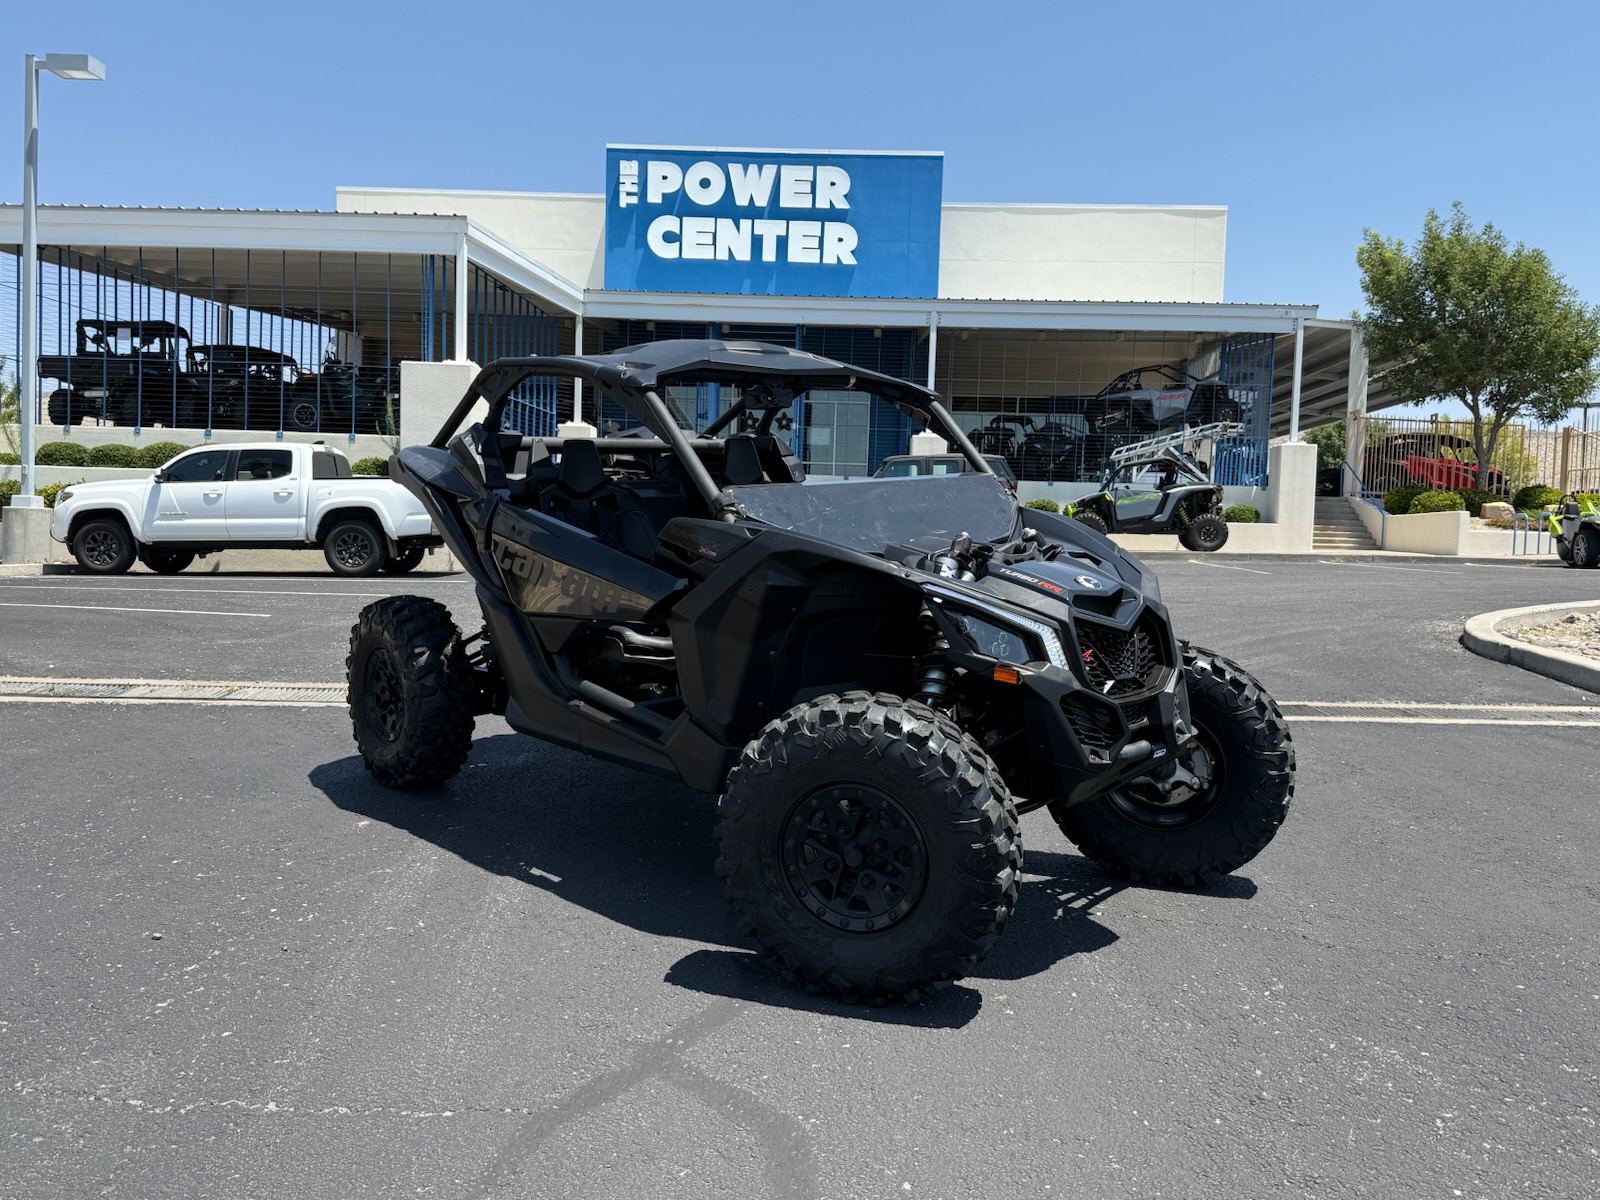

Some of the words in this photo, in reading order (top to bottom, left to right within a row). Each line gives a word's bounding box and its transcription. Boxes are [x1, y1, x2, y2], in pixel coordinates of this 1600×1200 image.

[619, 160, 639, 208] THE
[647, 160, 851, 209] POWER
[647, 214, 859, 265] CENTER
[999, 567, 1040, 583] TURBO
[1037, 580, 1064, 594] RR
